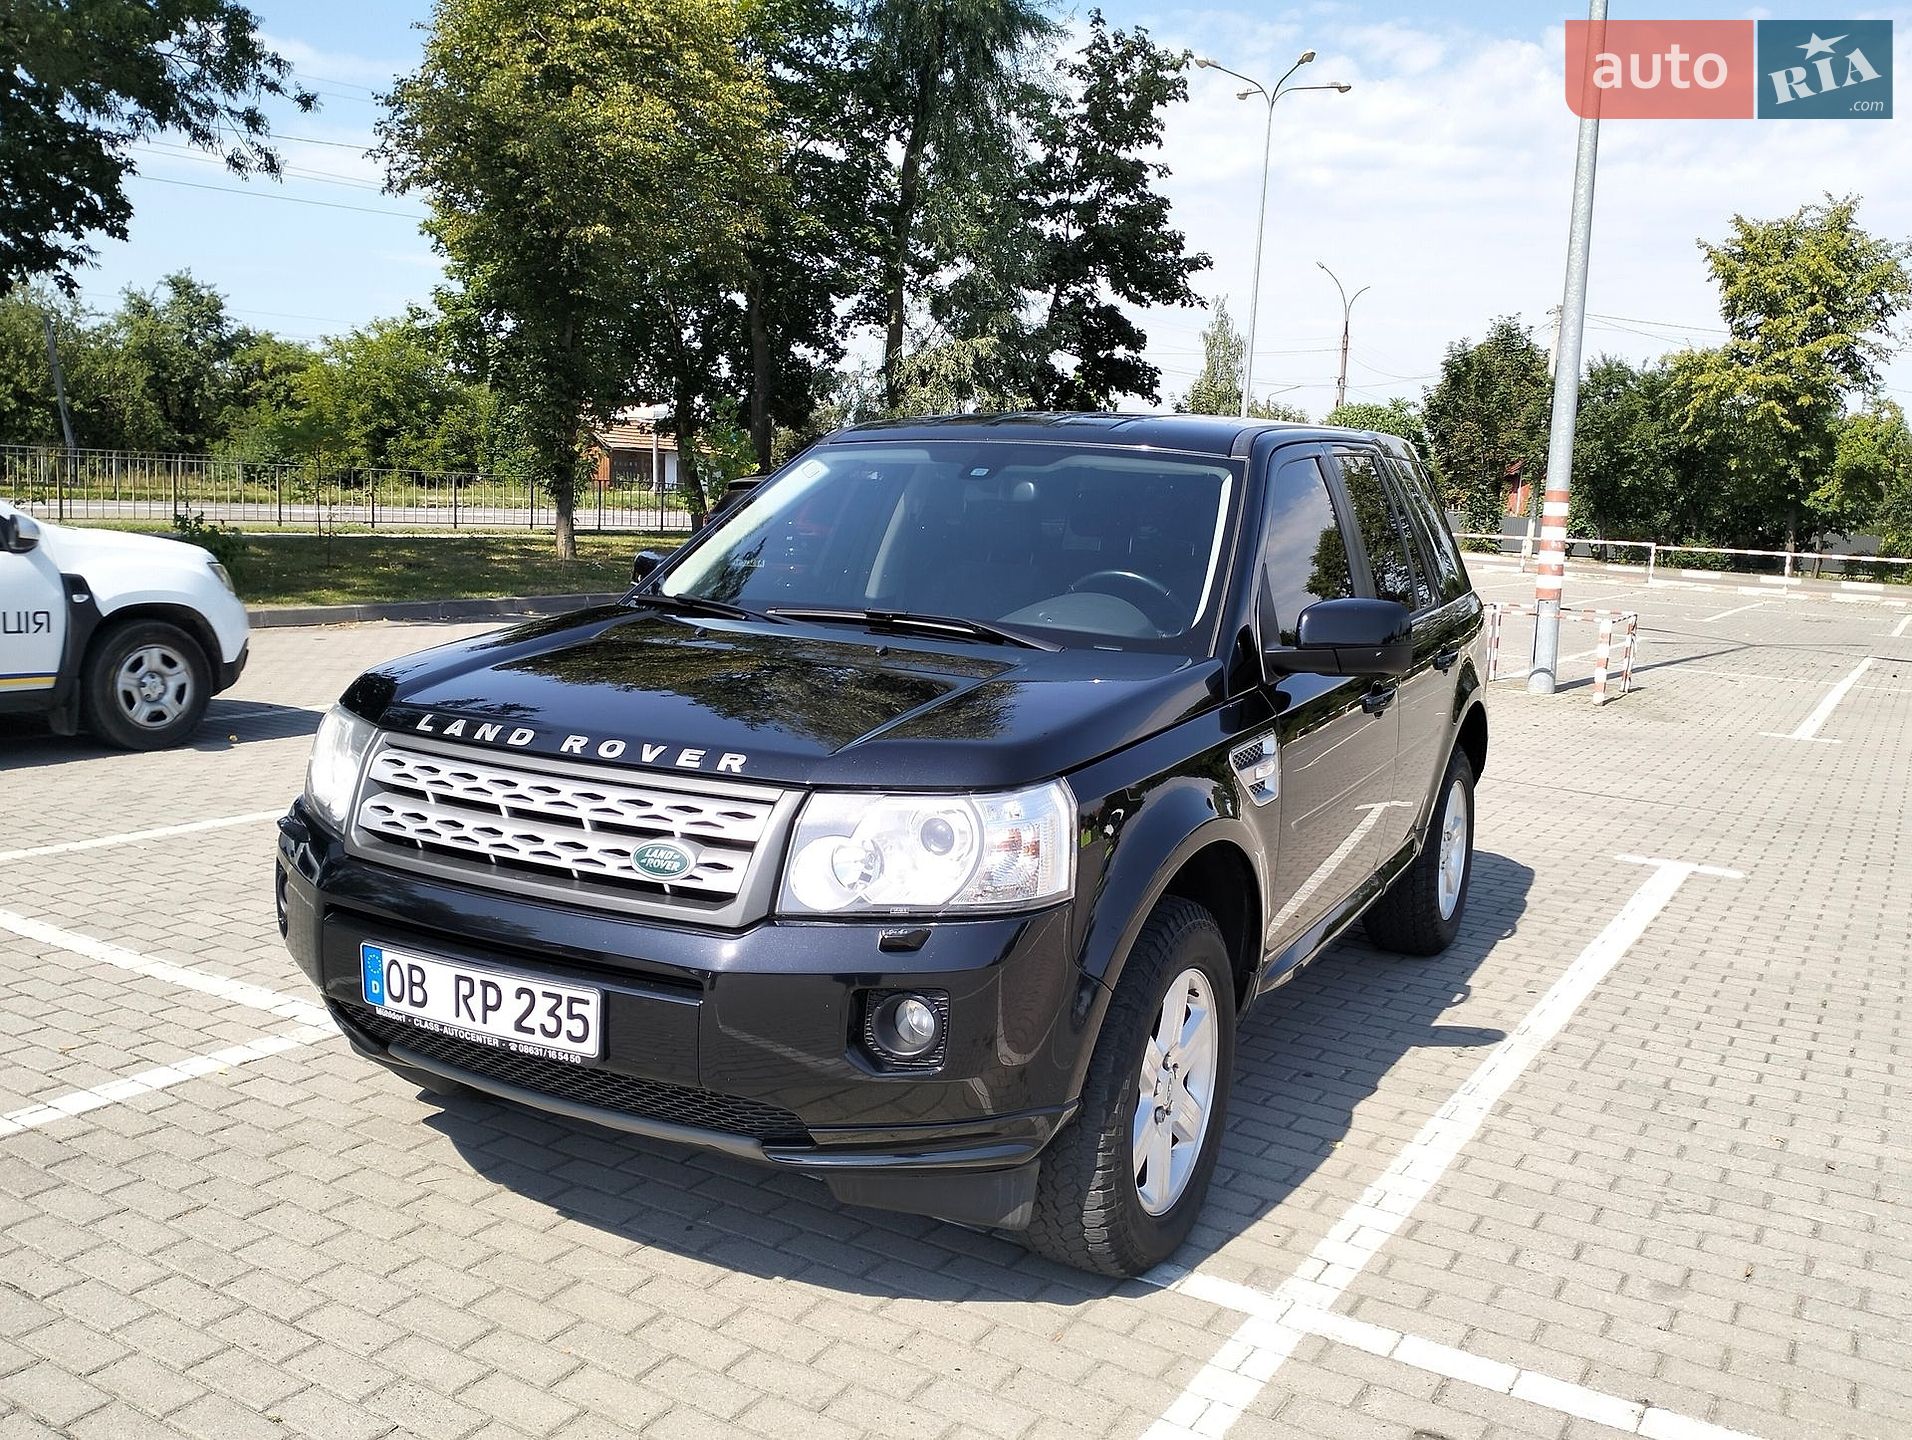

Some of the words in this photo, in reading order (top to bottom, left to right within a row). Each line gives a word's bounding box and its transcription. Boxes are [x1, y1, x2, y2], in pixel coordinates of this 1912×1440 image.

[415, 713, 536, 747] LAND
[559, 734, 748, 773] ROVER
[644, 847, 675, 860] LAND
[645, 857, 681, 871] ROVER
[371, 980, 380, 994] D
[385, 959, 429, 1009] OB
[454, 974, 503, 1024] RP
[513, 986, 590, 1044] 235
